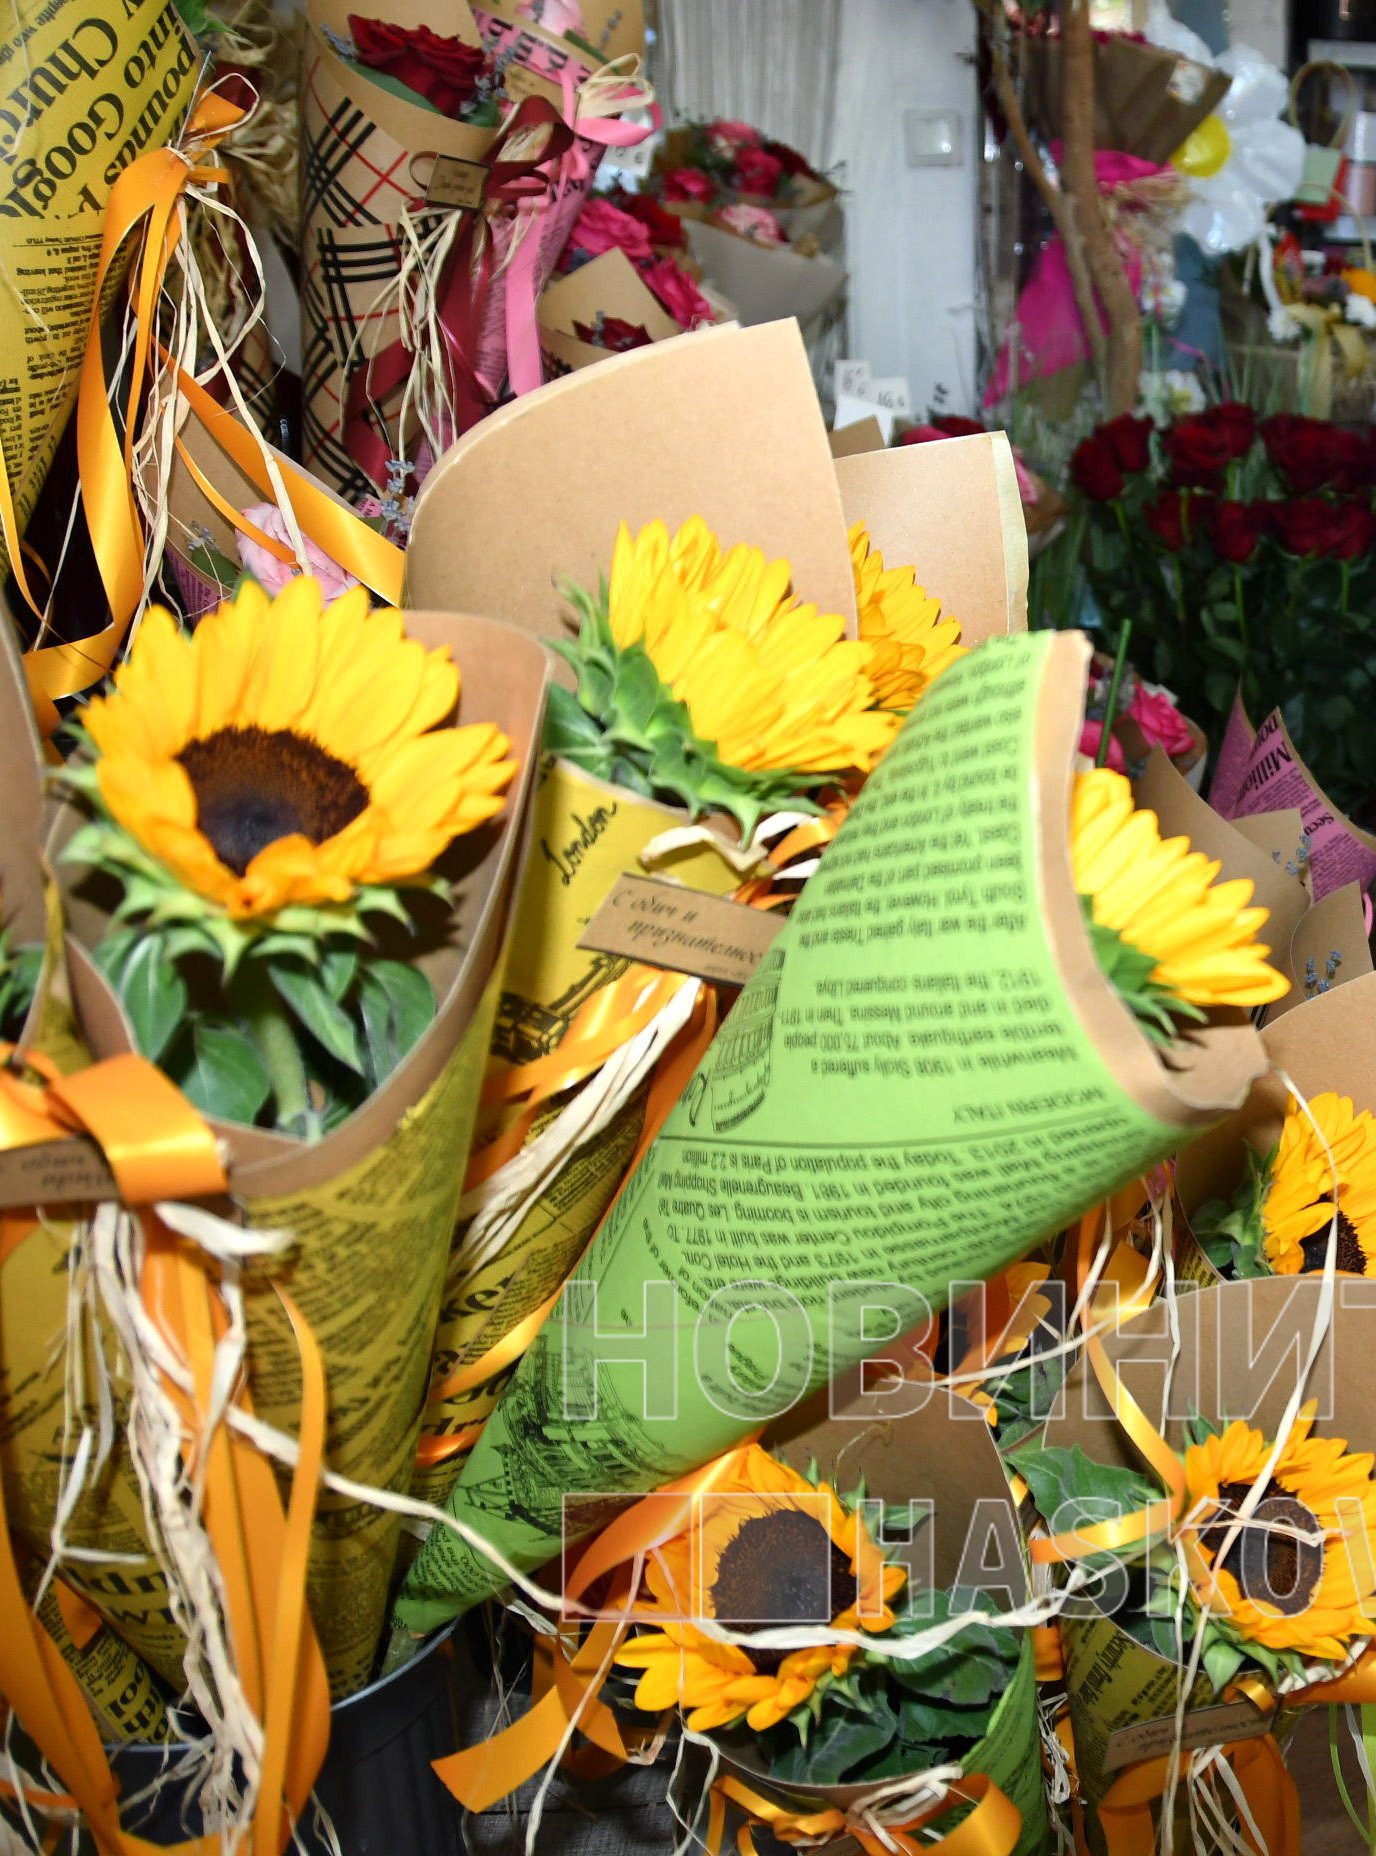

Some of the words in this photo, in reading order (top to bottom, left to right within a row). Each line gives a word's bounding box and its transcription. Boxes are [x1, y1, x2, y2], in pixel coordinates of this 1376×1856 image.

[541, 802, 617, 887] London
[1007, 1088, 1106, 1116] MODERN
[953, 1105, 1006, 1124] ITALY
[729, 1153, 738, 1170] is
[742, 1154, 771, 1174] Paris
[774, 1156, 787, 1174] of
[790, 1153, 867, 1176] population
[871, 1154, 900, 1171] the
[852, 1182, 871, 1198] in
[708, 1204, 729, 1222] Les
[811, 1206, 877, 1222] tourism
[714, 1230, 728, 1248] in
[729, 1231, 759, 1249] built
[713, 1254, 751, 1272] Hotel
[754, 1255, 779, 1271] the
